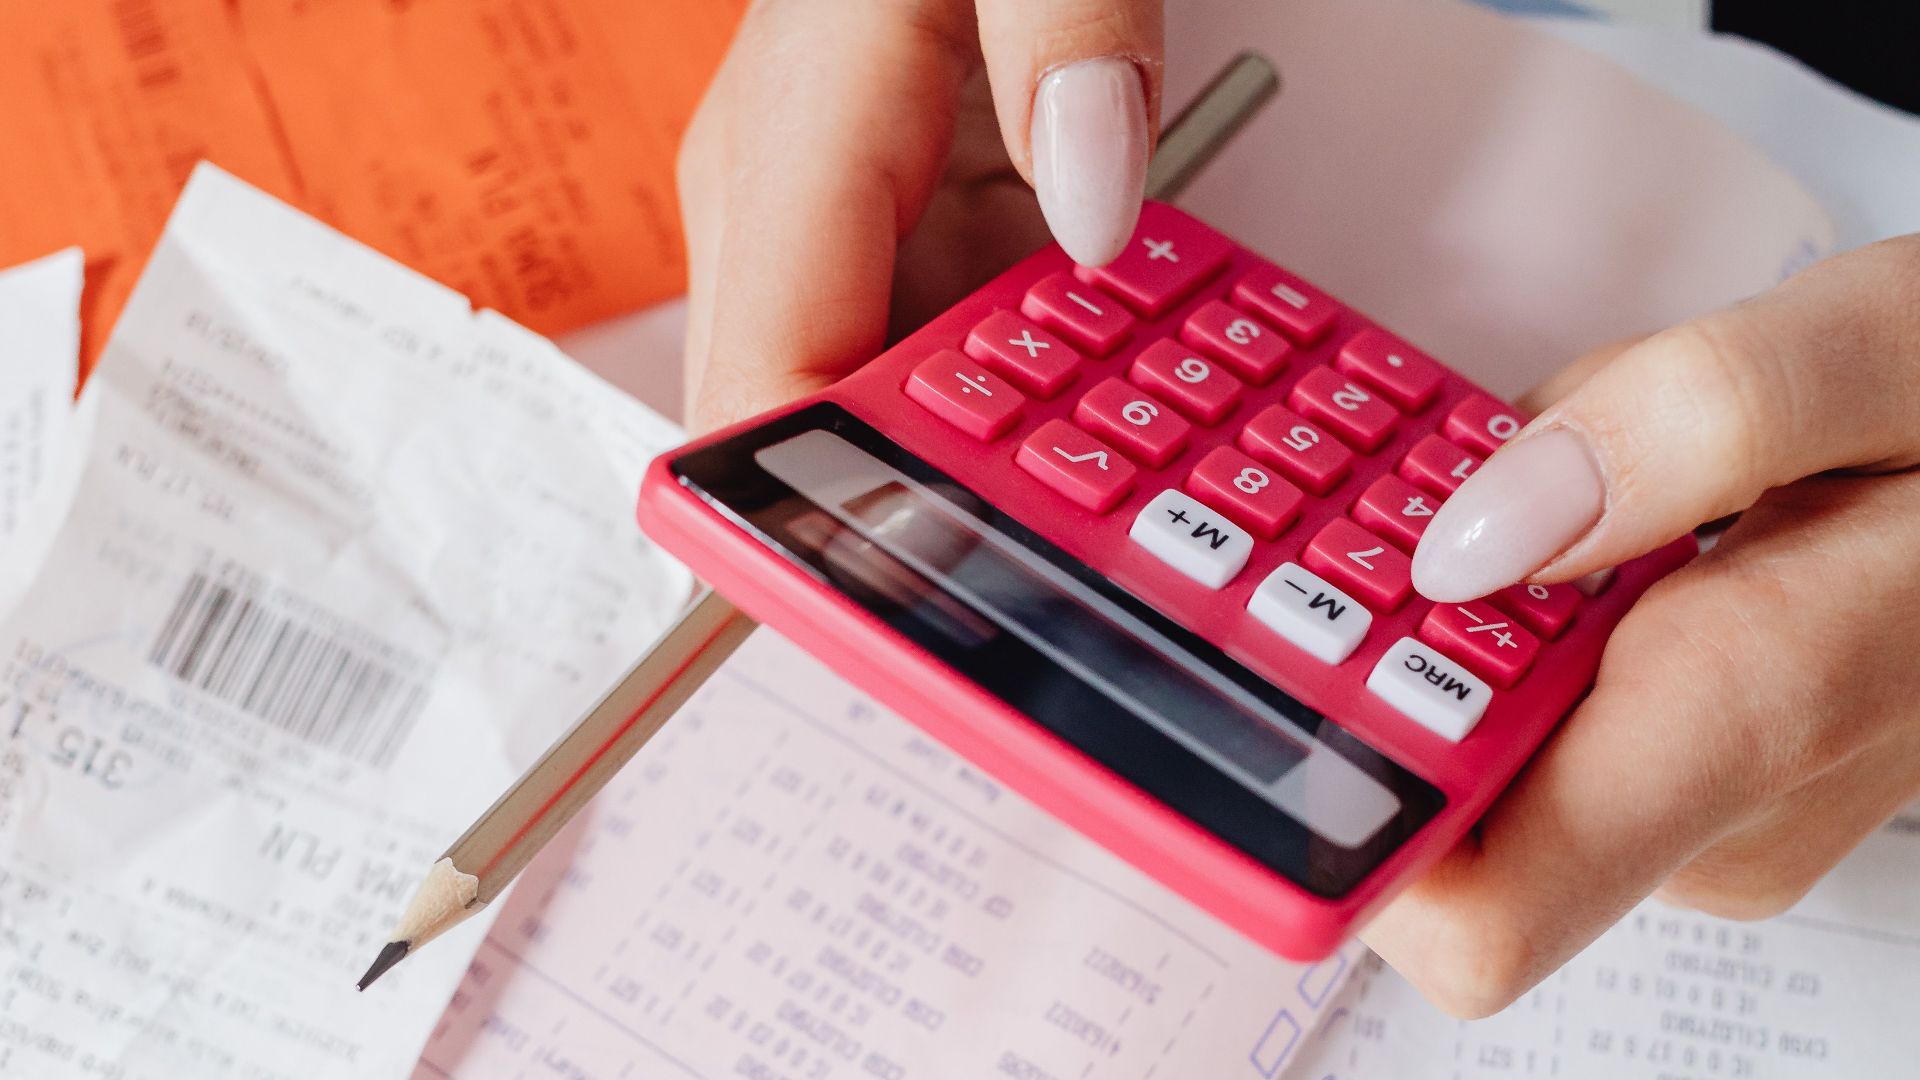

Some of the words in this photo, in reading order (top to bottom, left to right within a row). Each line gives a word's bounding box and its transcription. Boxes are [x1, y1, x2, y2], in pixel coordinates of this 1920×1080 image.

[1224, 318, 1261, 345] 3
[1173, 357, 1211, 384] 6
[1331, 382, 1370, 412] 2
[1121, 399, 1159, 426] 9
[1281, 425, 1320, 453] 5
[1486, 413, 1520, 441] 0
[1232, 466, 1270, 495] 8
[1401, 494, 1435, 518] 4
[1166, 507, 1230, 551] M+
[1346, 545, 1385, 572] 7
[1403, 653, 1472, 702] MRC
